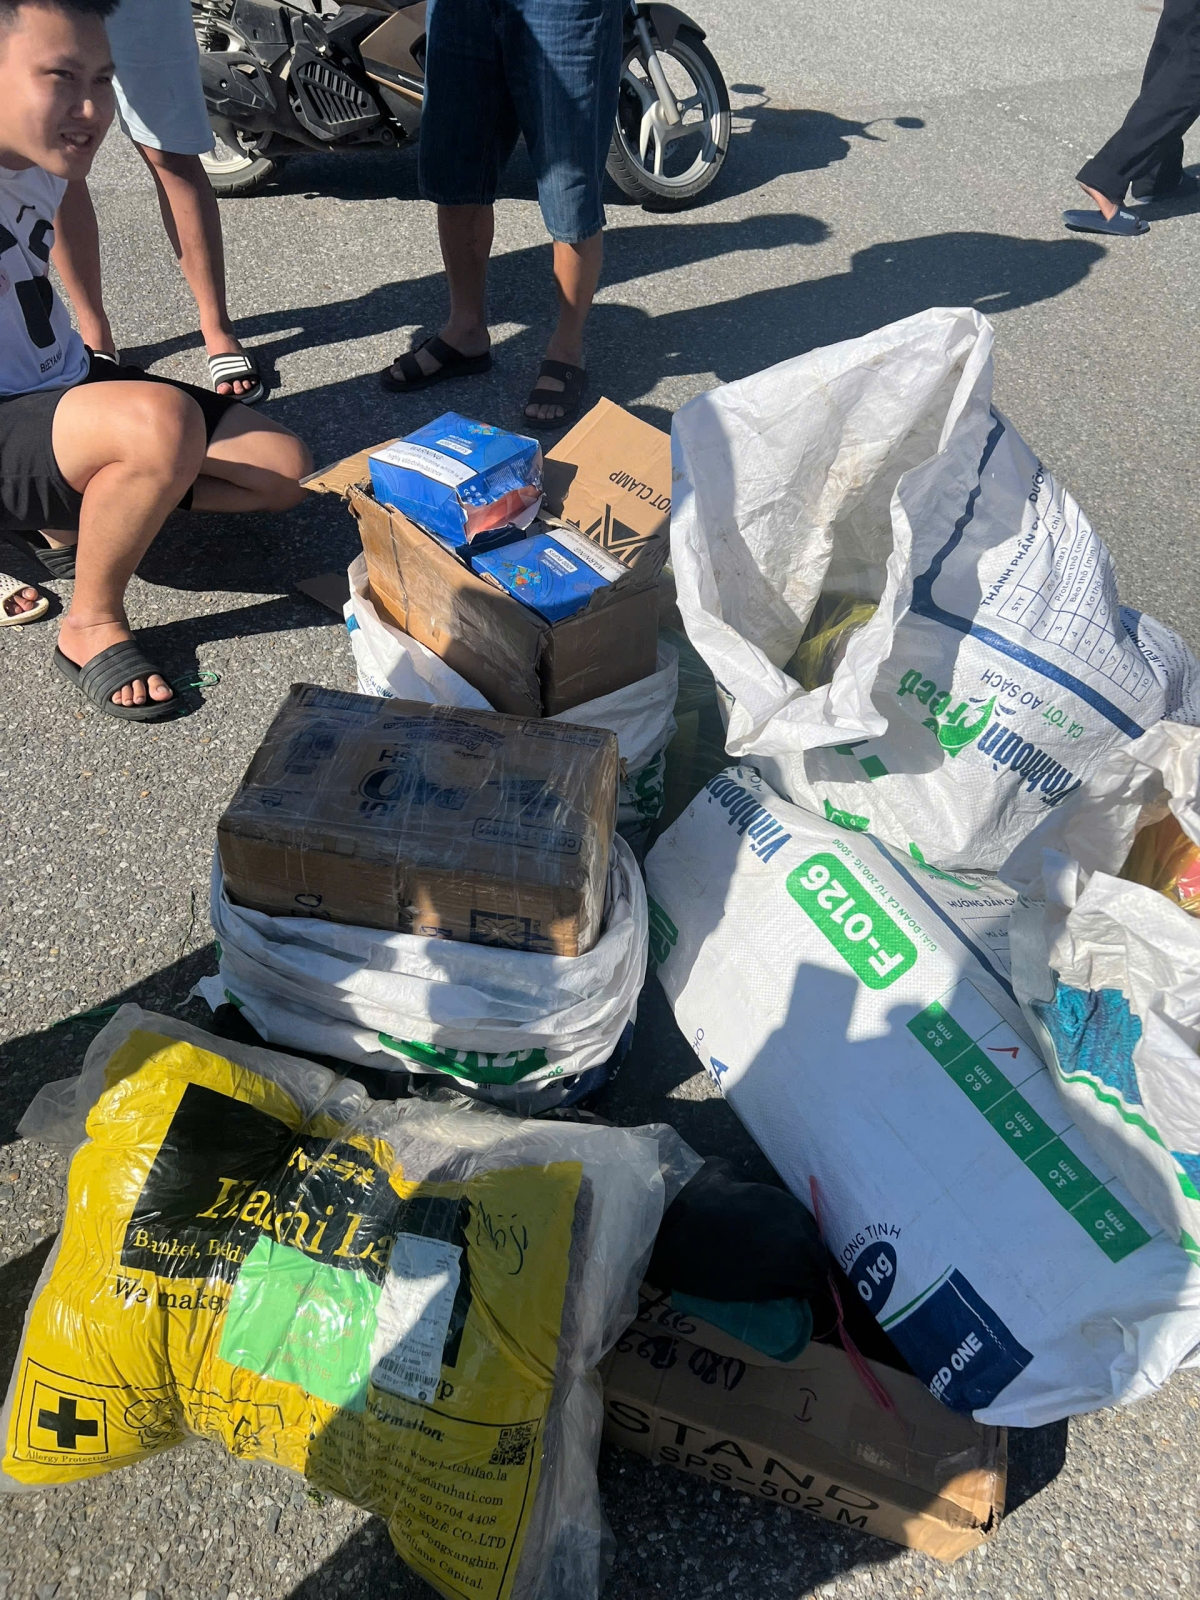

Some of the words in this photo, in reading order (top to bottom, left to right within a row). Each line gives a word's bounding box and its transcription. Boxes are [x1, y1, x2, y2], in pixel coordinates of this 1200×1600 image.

[608, 470, 654, 500] CLAMP
[980, 569, 1014, 607] THÀNH
[1011, 533, 1036, 567] PHẦN
[1055, 577, 1070, 602] Protein
[1011, 596, 1026, 612] STT
[1042, 620, 1048, 628] 2
[979, 668, 1022, 698] SẠCH
[1141, 677, 1149, 689] 10
[1020, 691, 1043, 710] AO
[1062, 725, 1084, 739] CÁ
[831, 838, 853, 857] 500G
[884, 896, 900, 909] CÁ
[800, 864, 906, 978] F-0126
[920, 931, 938, 952] GIAI
[926, 1030, 943, 1048] 8.0
[936, 1021, 953, 1040] mm
[964, 1073, 982, 1091] 6.0
[973, 1065, 992, 1085] mm
[1005, 1120, 1023, 1138] 4.0
[1014, 1111, 1034, 1132] mm
[1048, 1169, 1067, 1188] 3.0
[1057, 1160, 1079, 1181] mm
[1094, 1219, 1116, 1239] 2.0
[1104, 1209, 1126, 1232] mm
[864, 1222, 901, 1241] TỊNH
[865, 1252, 894, 1286] kg
[115, 1274, 148, 1303] We
[157, 1290, 224, 1312] make
[951, 1331, 983, 1372] ONE
[25, 1450, 59, 1464] Allergy
[61, 1453, 112, 1463] Protection
[607, 1400, 880, 1511] STAND
[659, 1446, 825, 1514] SPS-502
[836, 1507, 869, 1528] M
[418, 1510, 450, 1532] SOLE
[435, 1501, 463, 1520] 5704
[466, 1512, 497, 1526] 4408
[439, 1560, 485, 1591] Capital,
